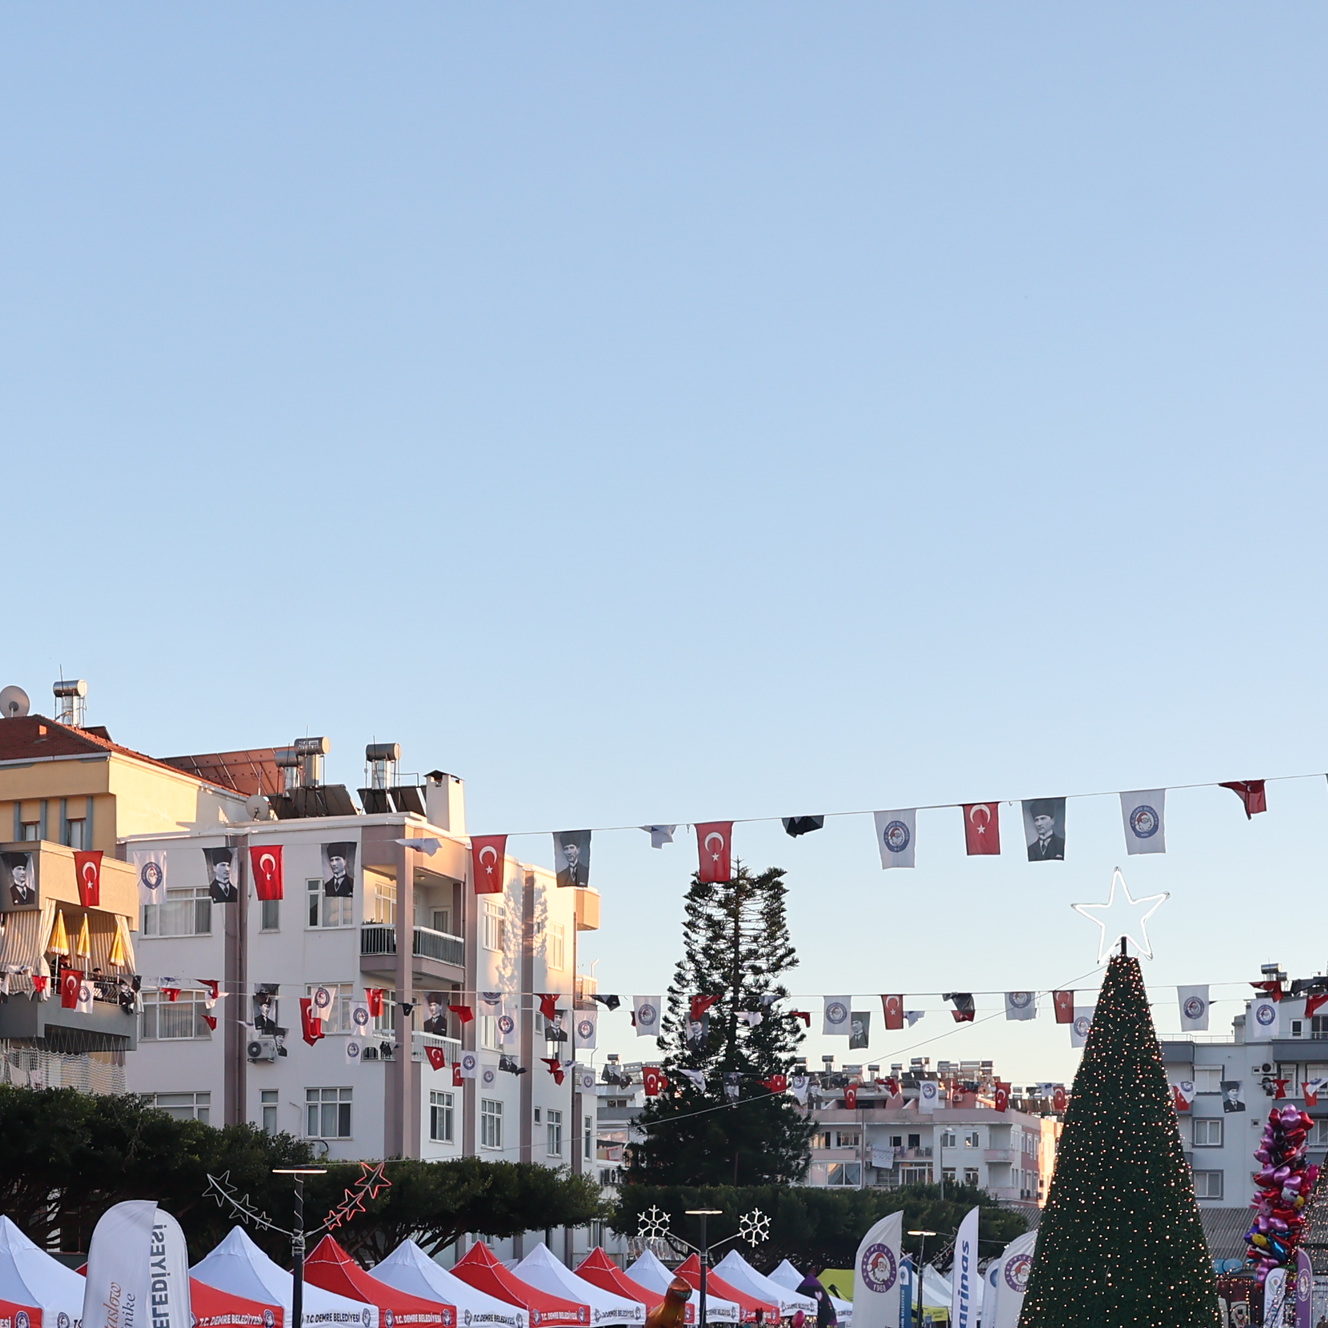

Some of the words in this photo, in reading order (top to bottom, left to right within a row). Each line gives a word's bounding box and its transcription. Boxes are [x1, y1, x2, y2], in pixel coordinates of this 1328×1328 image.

[209, 1314, 231, 1326] DEMRE
[230, 1312, 264, 1326] BELEDİYESİ
[333, 1311, 361, 1323] BELEDİYESİ
